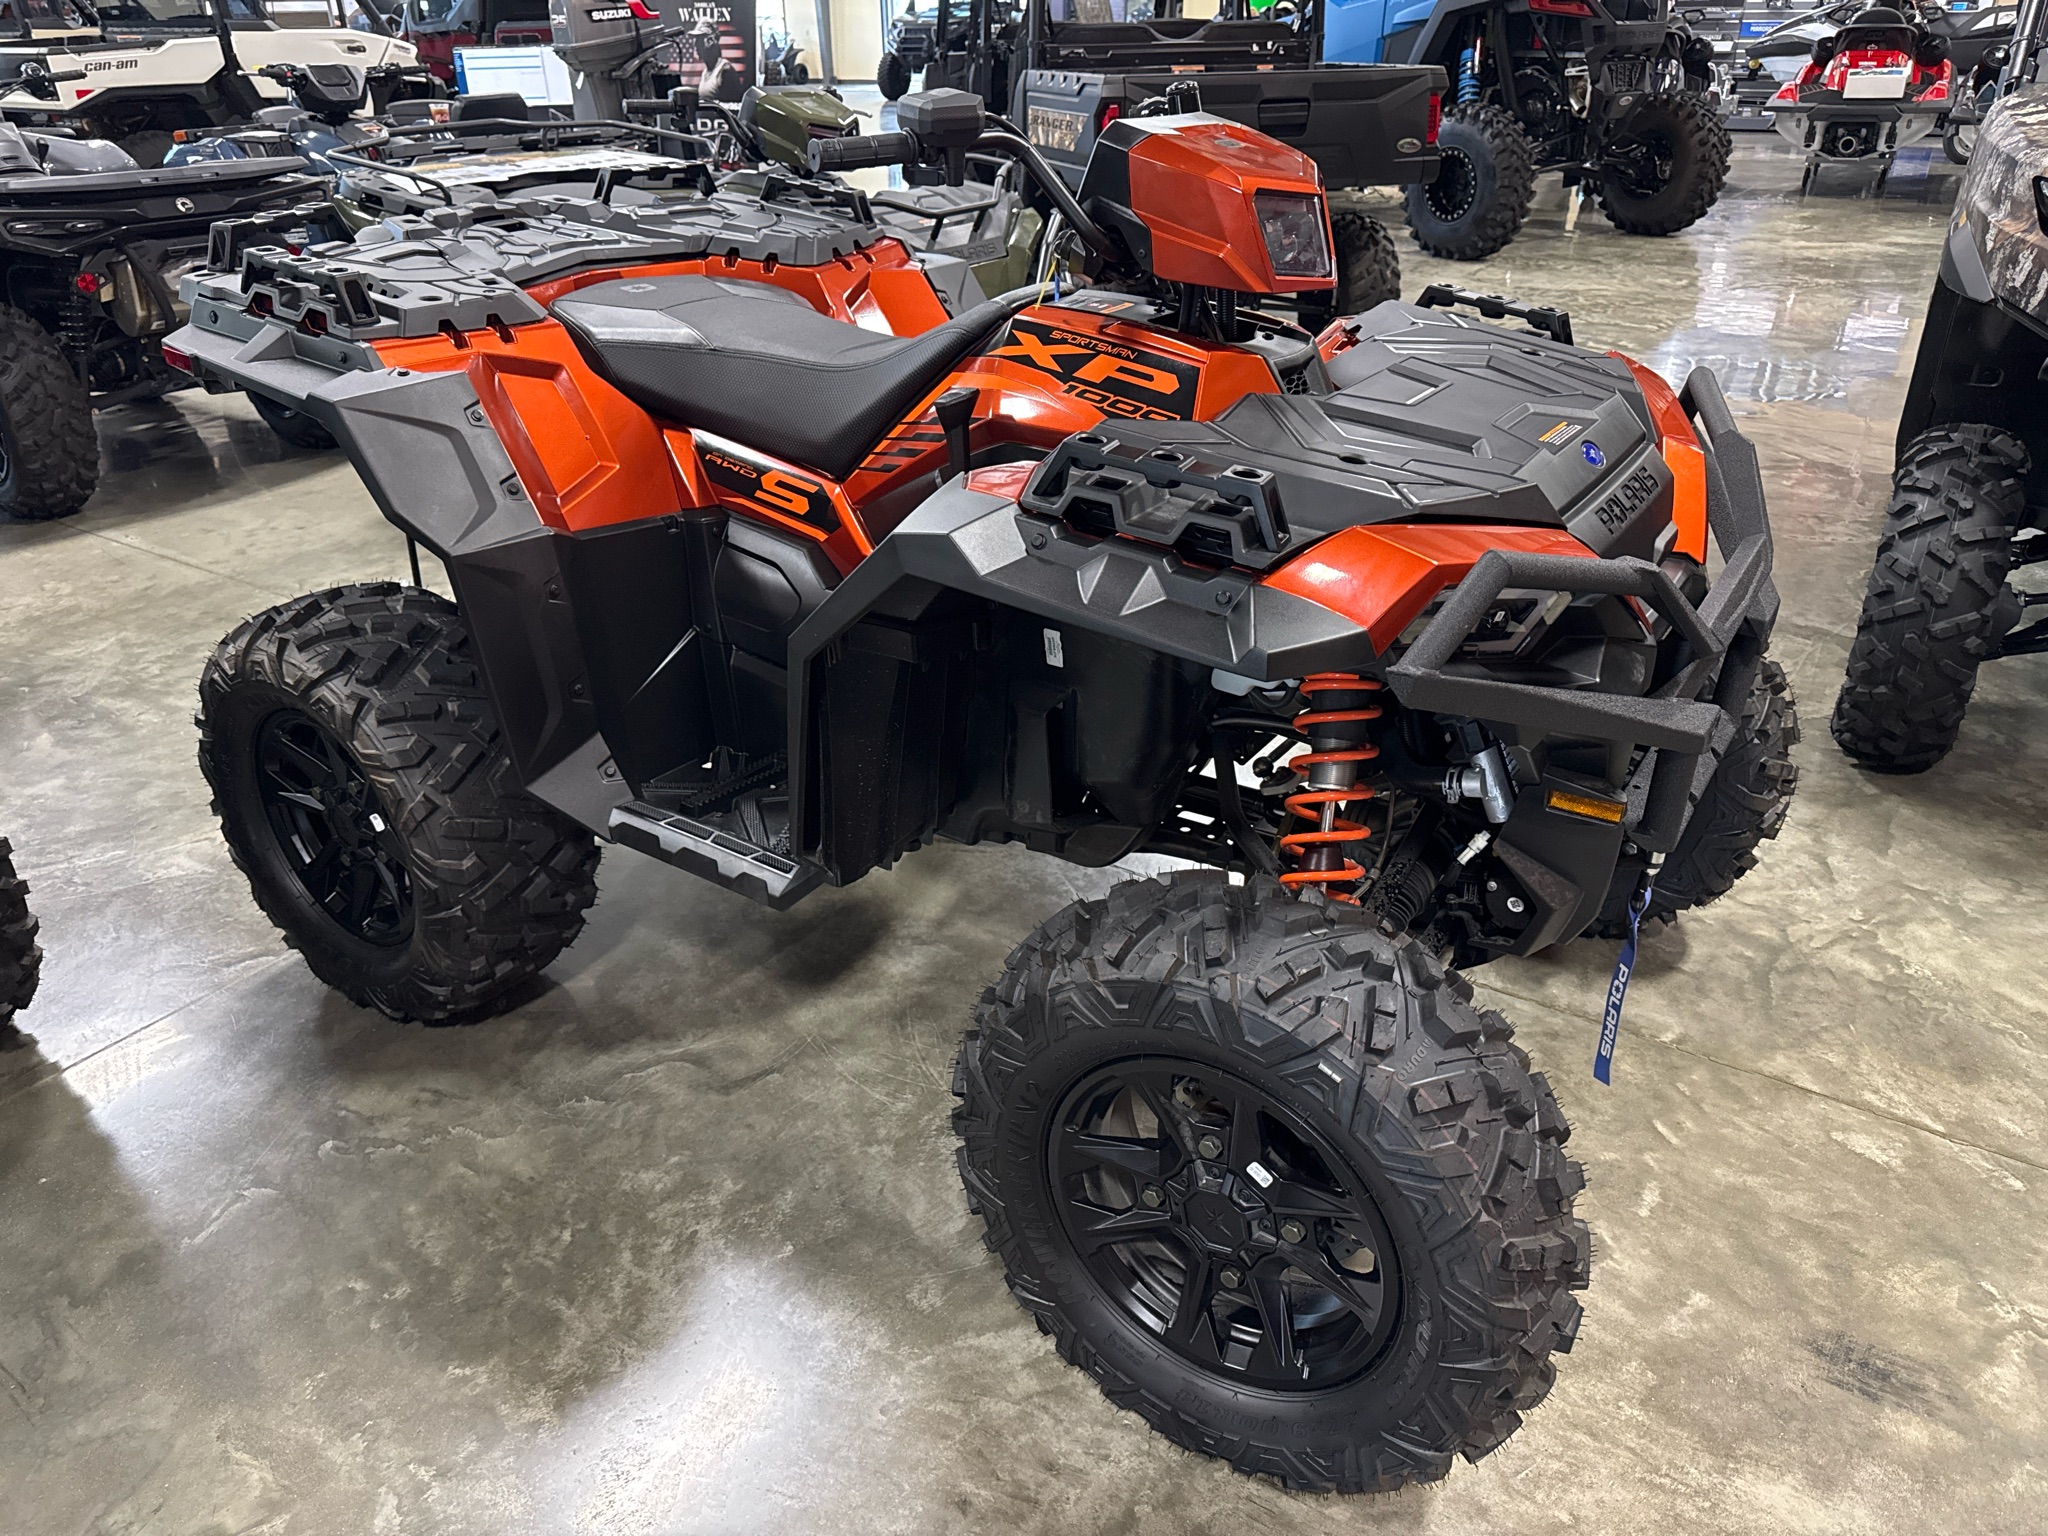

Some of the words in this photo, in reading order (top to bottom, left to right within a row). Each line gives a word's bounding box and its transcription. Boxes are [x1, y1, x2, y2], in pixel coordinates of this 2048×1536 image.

[551, 15, 566, 28] 25
[591, 8, 632, 20] SUZUKI
[678, 7, 732, 22] WALLEN
[84, 59, 138, 72] can-am
[1031, 114, 1074, 132] RANGER
[951, 243, 998, 259] OLARIS
[1049, 330, 1138, 360] SPORTSMAN
[986, 329, 1180, 395] XP
[705, 454, 758, 479] AWD
[754, 469, 820, 516] S
[1595, 466, 1659, 535] POLARIS
[1600, 963, 1629, 1059] POLARIS
